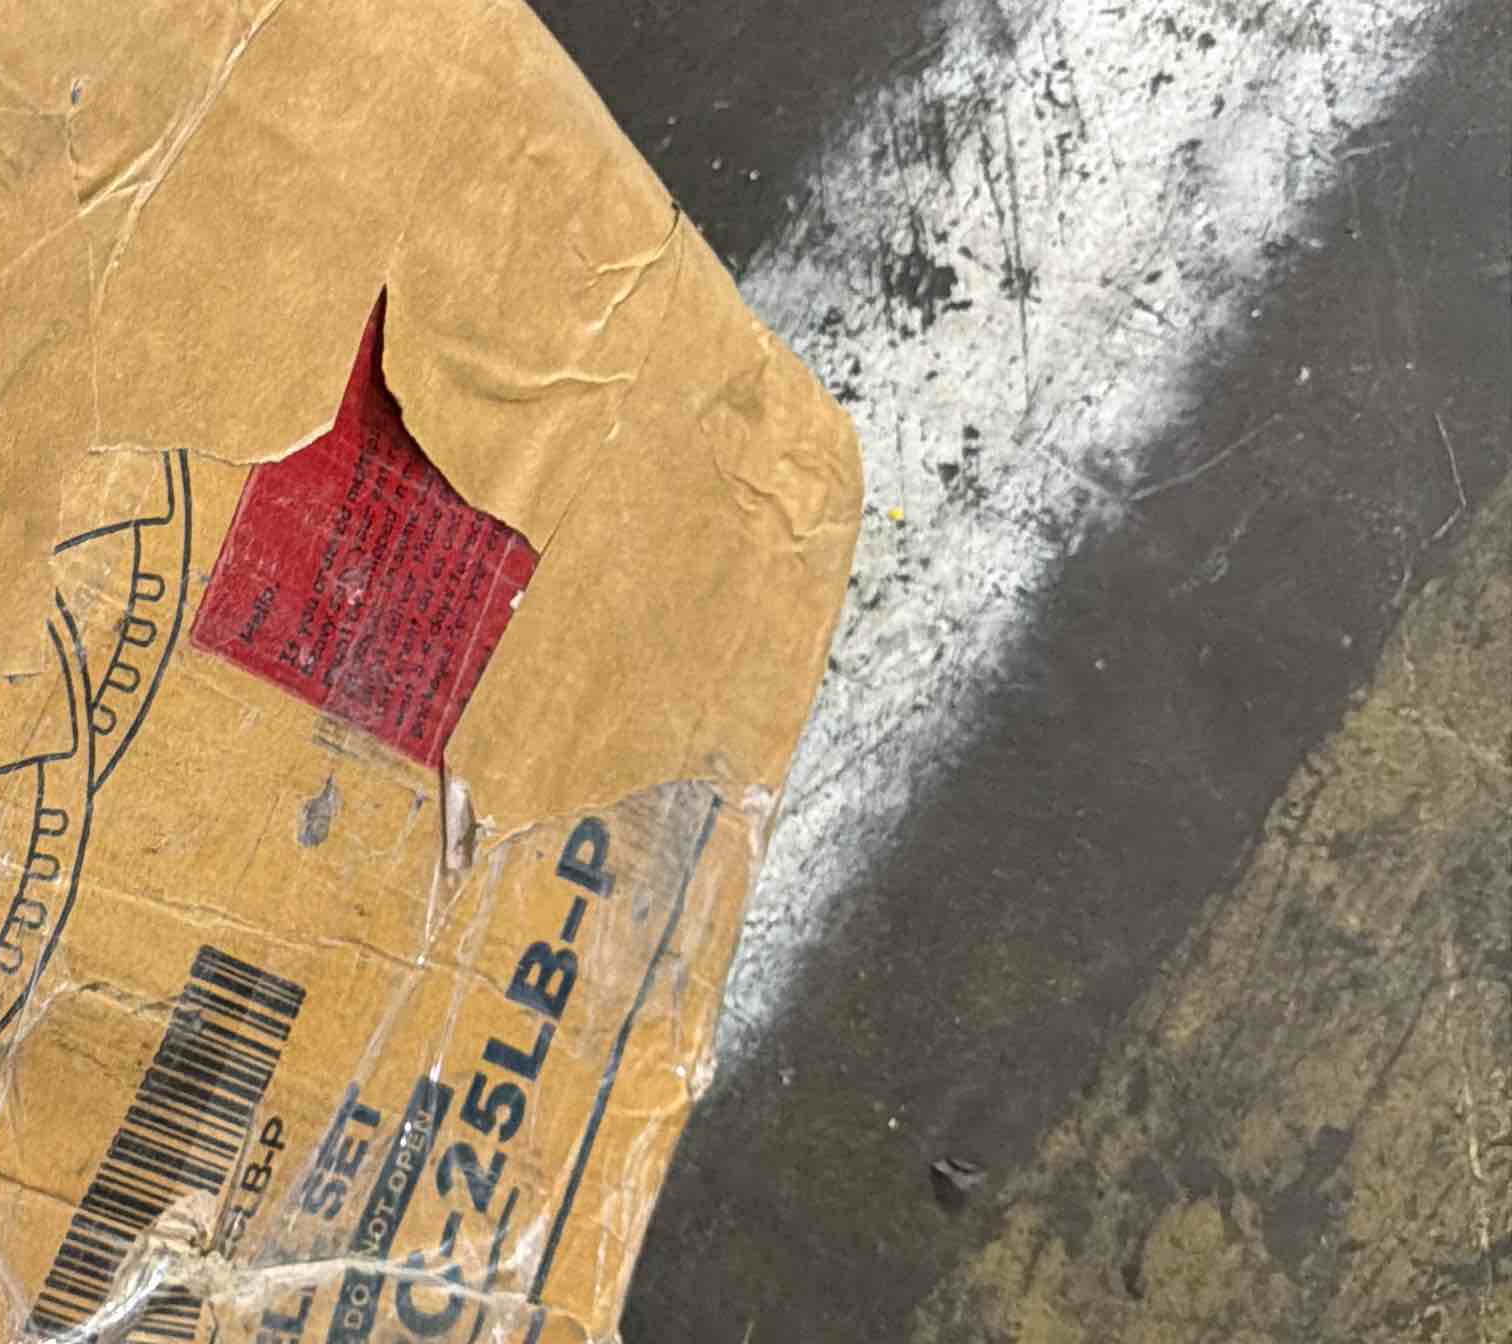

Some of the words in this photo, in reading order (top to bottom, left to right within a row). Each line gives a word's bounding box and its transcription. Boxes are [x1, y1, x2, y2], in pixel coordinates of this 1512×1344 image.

[303, 1081, 381, 1218] SET
[341, 1281, 373, 1330] DO
[388, 1108, 434, 1194] OPEN
